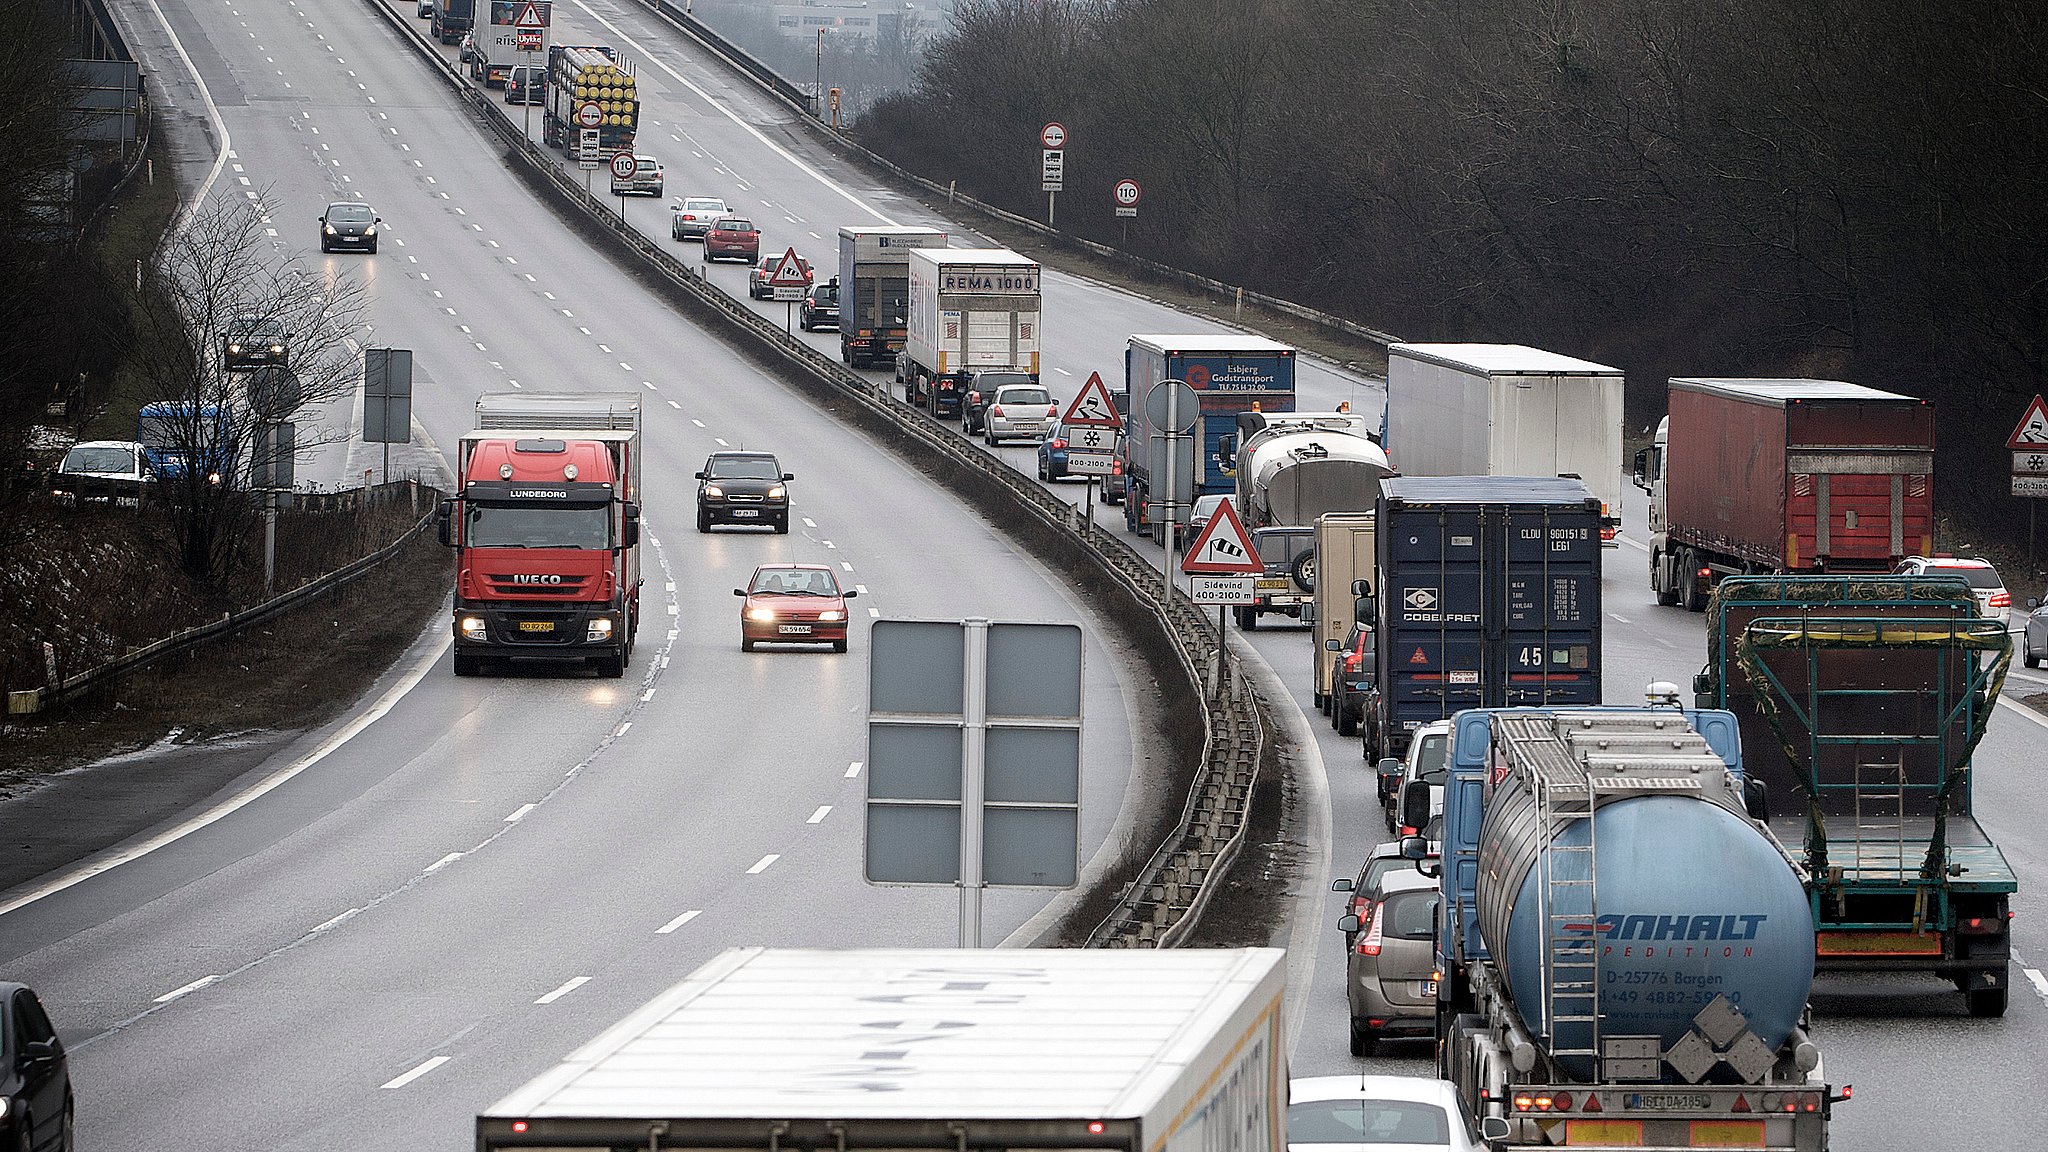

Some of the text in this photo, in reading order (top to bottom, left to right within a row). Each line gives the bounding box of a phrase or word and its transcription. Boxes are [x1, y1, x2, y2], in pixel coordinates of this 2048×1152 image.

[615, 161, 632, 170] 110
[1119, 188, 1136, 198] 110
[946, 278, 1032, 289] REMA 1000
[1227, 365, 1259, 375] Esbjerg
[1211, 373, 1274, 384] Godstransport
[510, 490, 567, 498] LUNDEBORG
[1550, 528, 1578, 539] 960151
[1580, 528, 1588, 540] 9
[514, 574, 561, 585] IVECO
[1204, 581, 1243, 589] Sidevind
[1195, 591, 1241, 599] 400-2100
[1415, 593, 1426, 605] C
[1404, 613, 1480, 622] COBELFRET
[1519, 647, 1542, 666] 45
[1584, 946, 1752, 958] PEDITION
[1606, 971, 1723, 987] D-25776 Bargen
